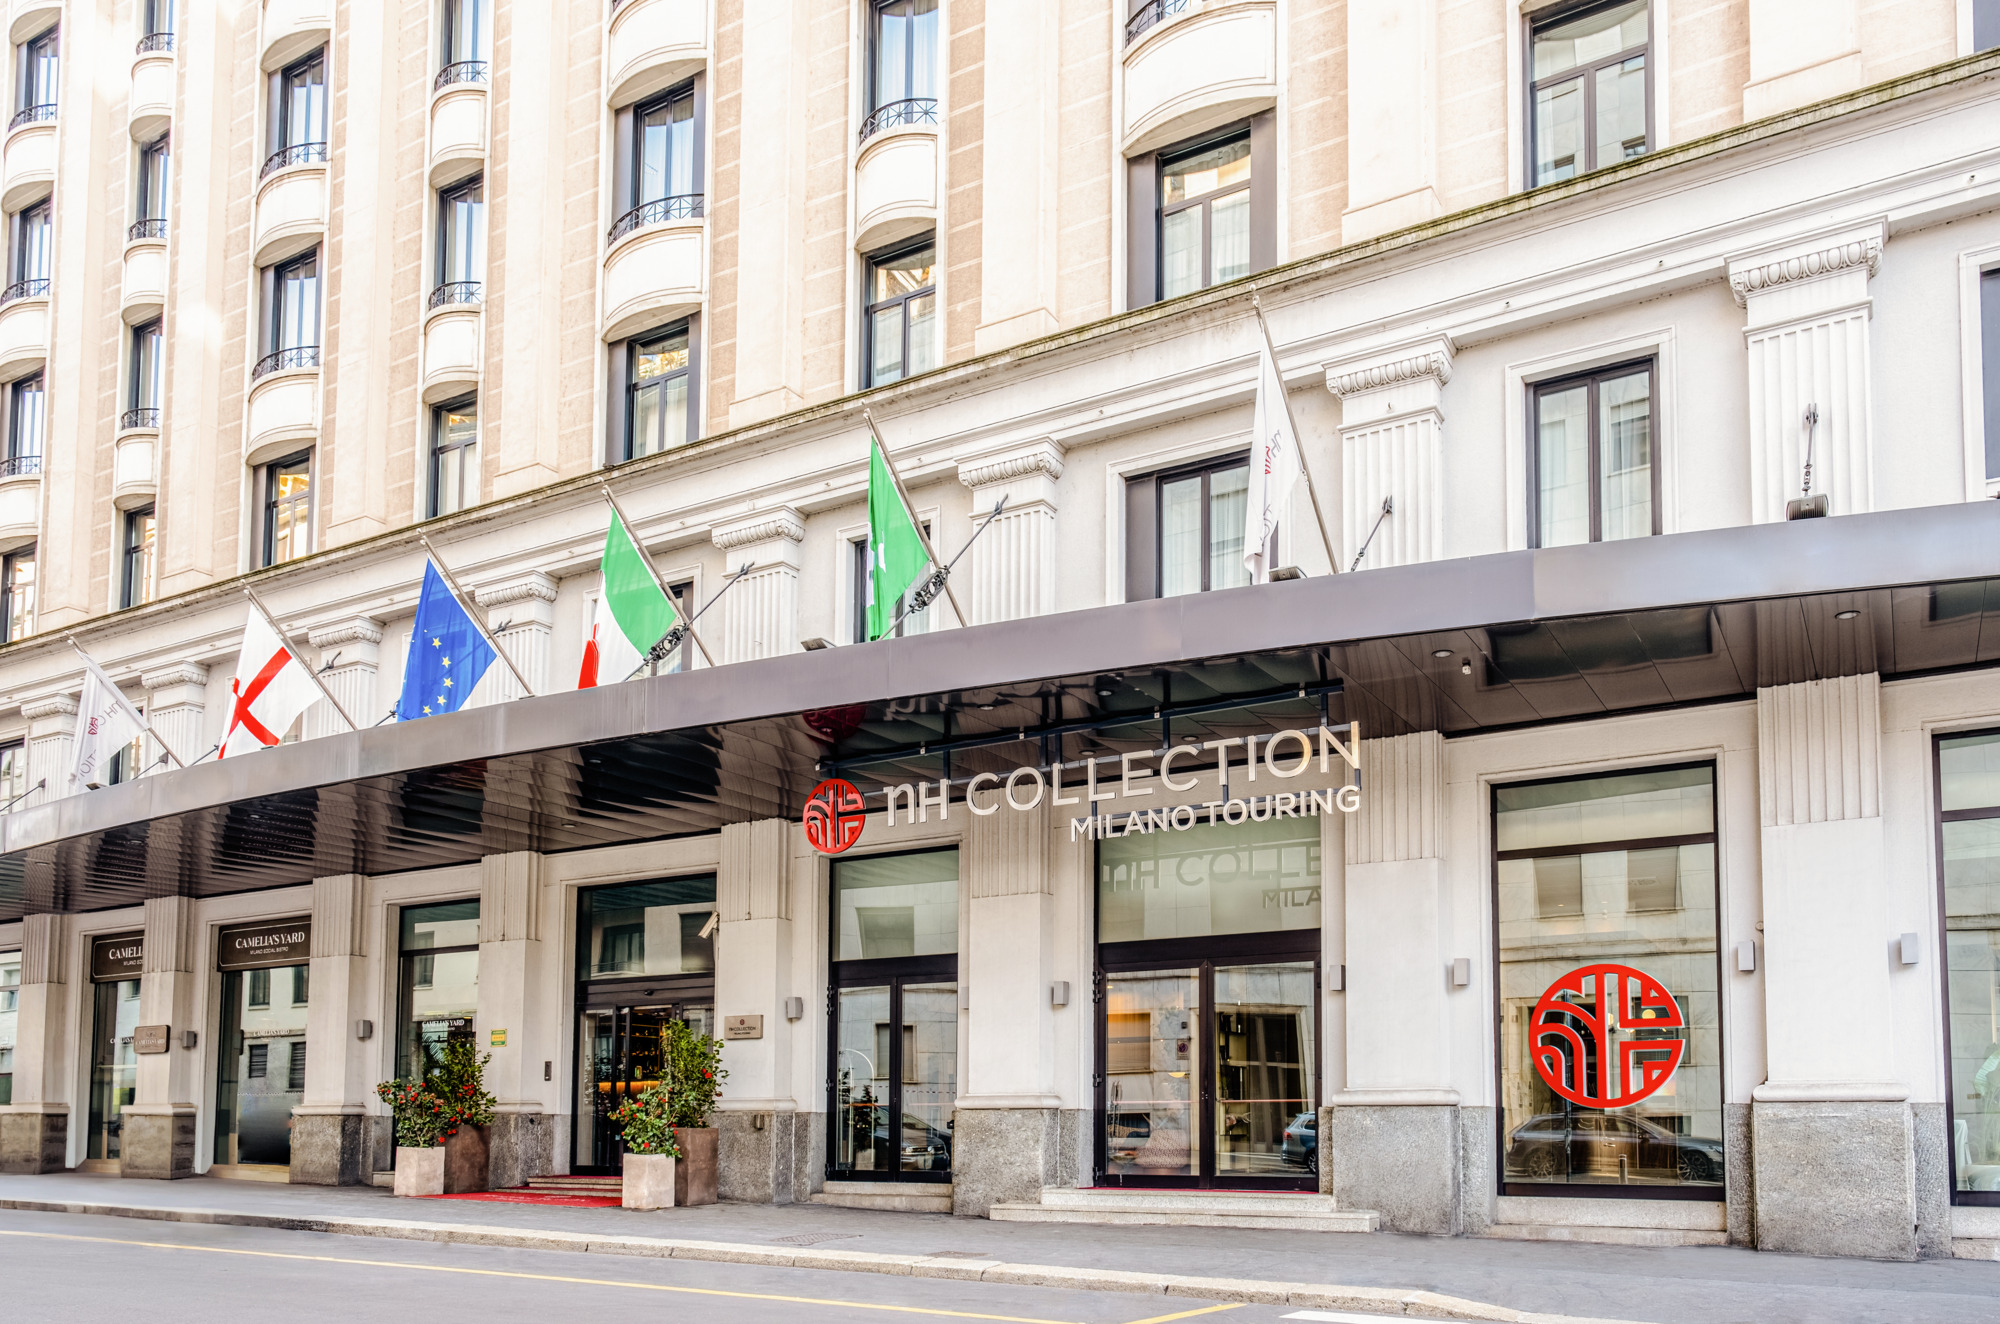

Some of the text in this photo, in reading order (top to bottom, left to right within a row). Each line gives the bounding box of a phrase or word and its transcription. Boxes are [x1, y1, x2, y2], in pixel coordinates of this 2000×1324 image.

[967, 721, 1361, 815] COLLECTION
[1071, 784, 1361, 842] MILANO TOURING
[109, 946, 143, 959] CAMELI
[236, 932, 304, 948] CAMELIA'S YARD
